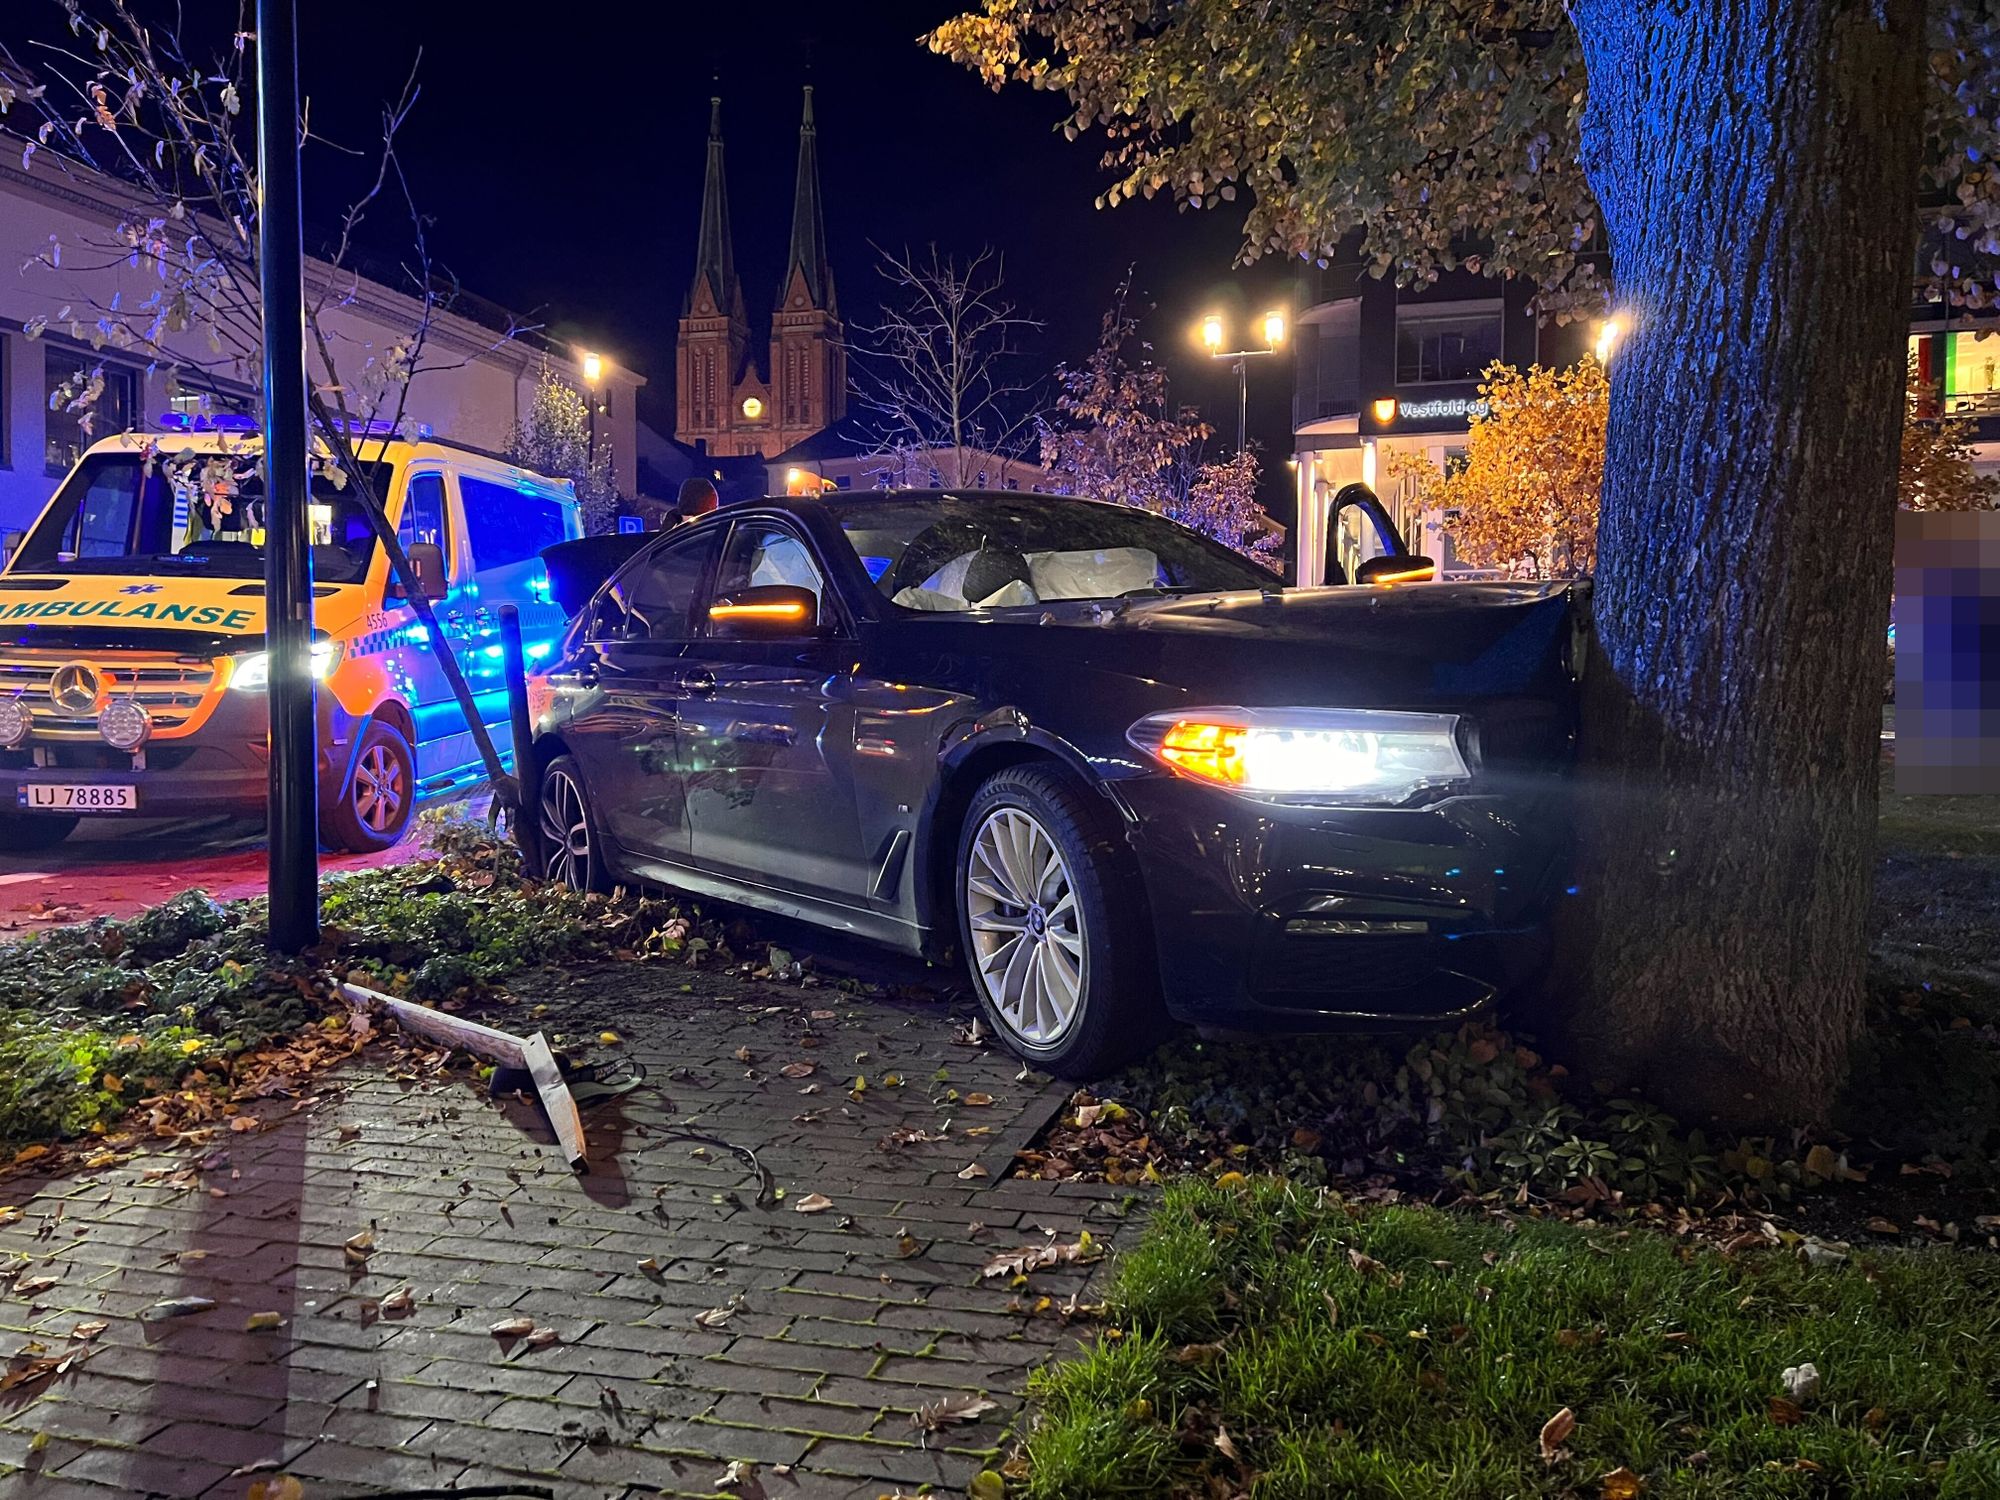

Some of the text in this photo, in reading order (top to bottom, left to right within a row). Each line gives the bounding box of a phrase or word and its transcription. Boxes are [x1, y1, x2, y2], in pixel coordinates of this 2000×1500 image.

[1400, 400, 1489, 418] Vestfold og
[0, 601, 256, 629] MBULANSE
[366, 612, 388, 631] 4556
[35, 788, 127, 806] LJ 78885
